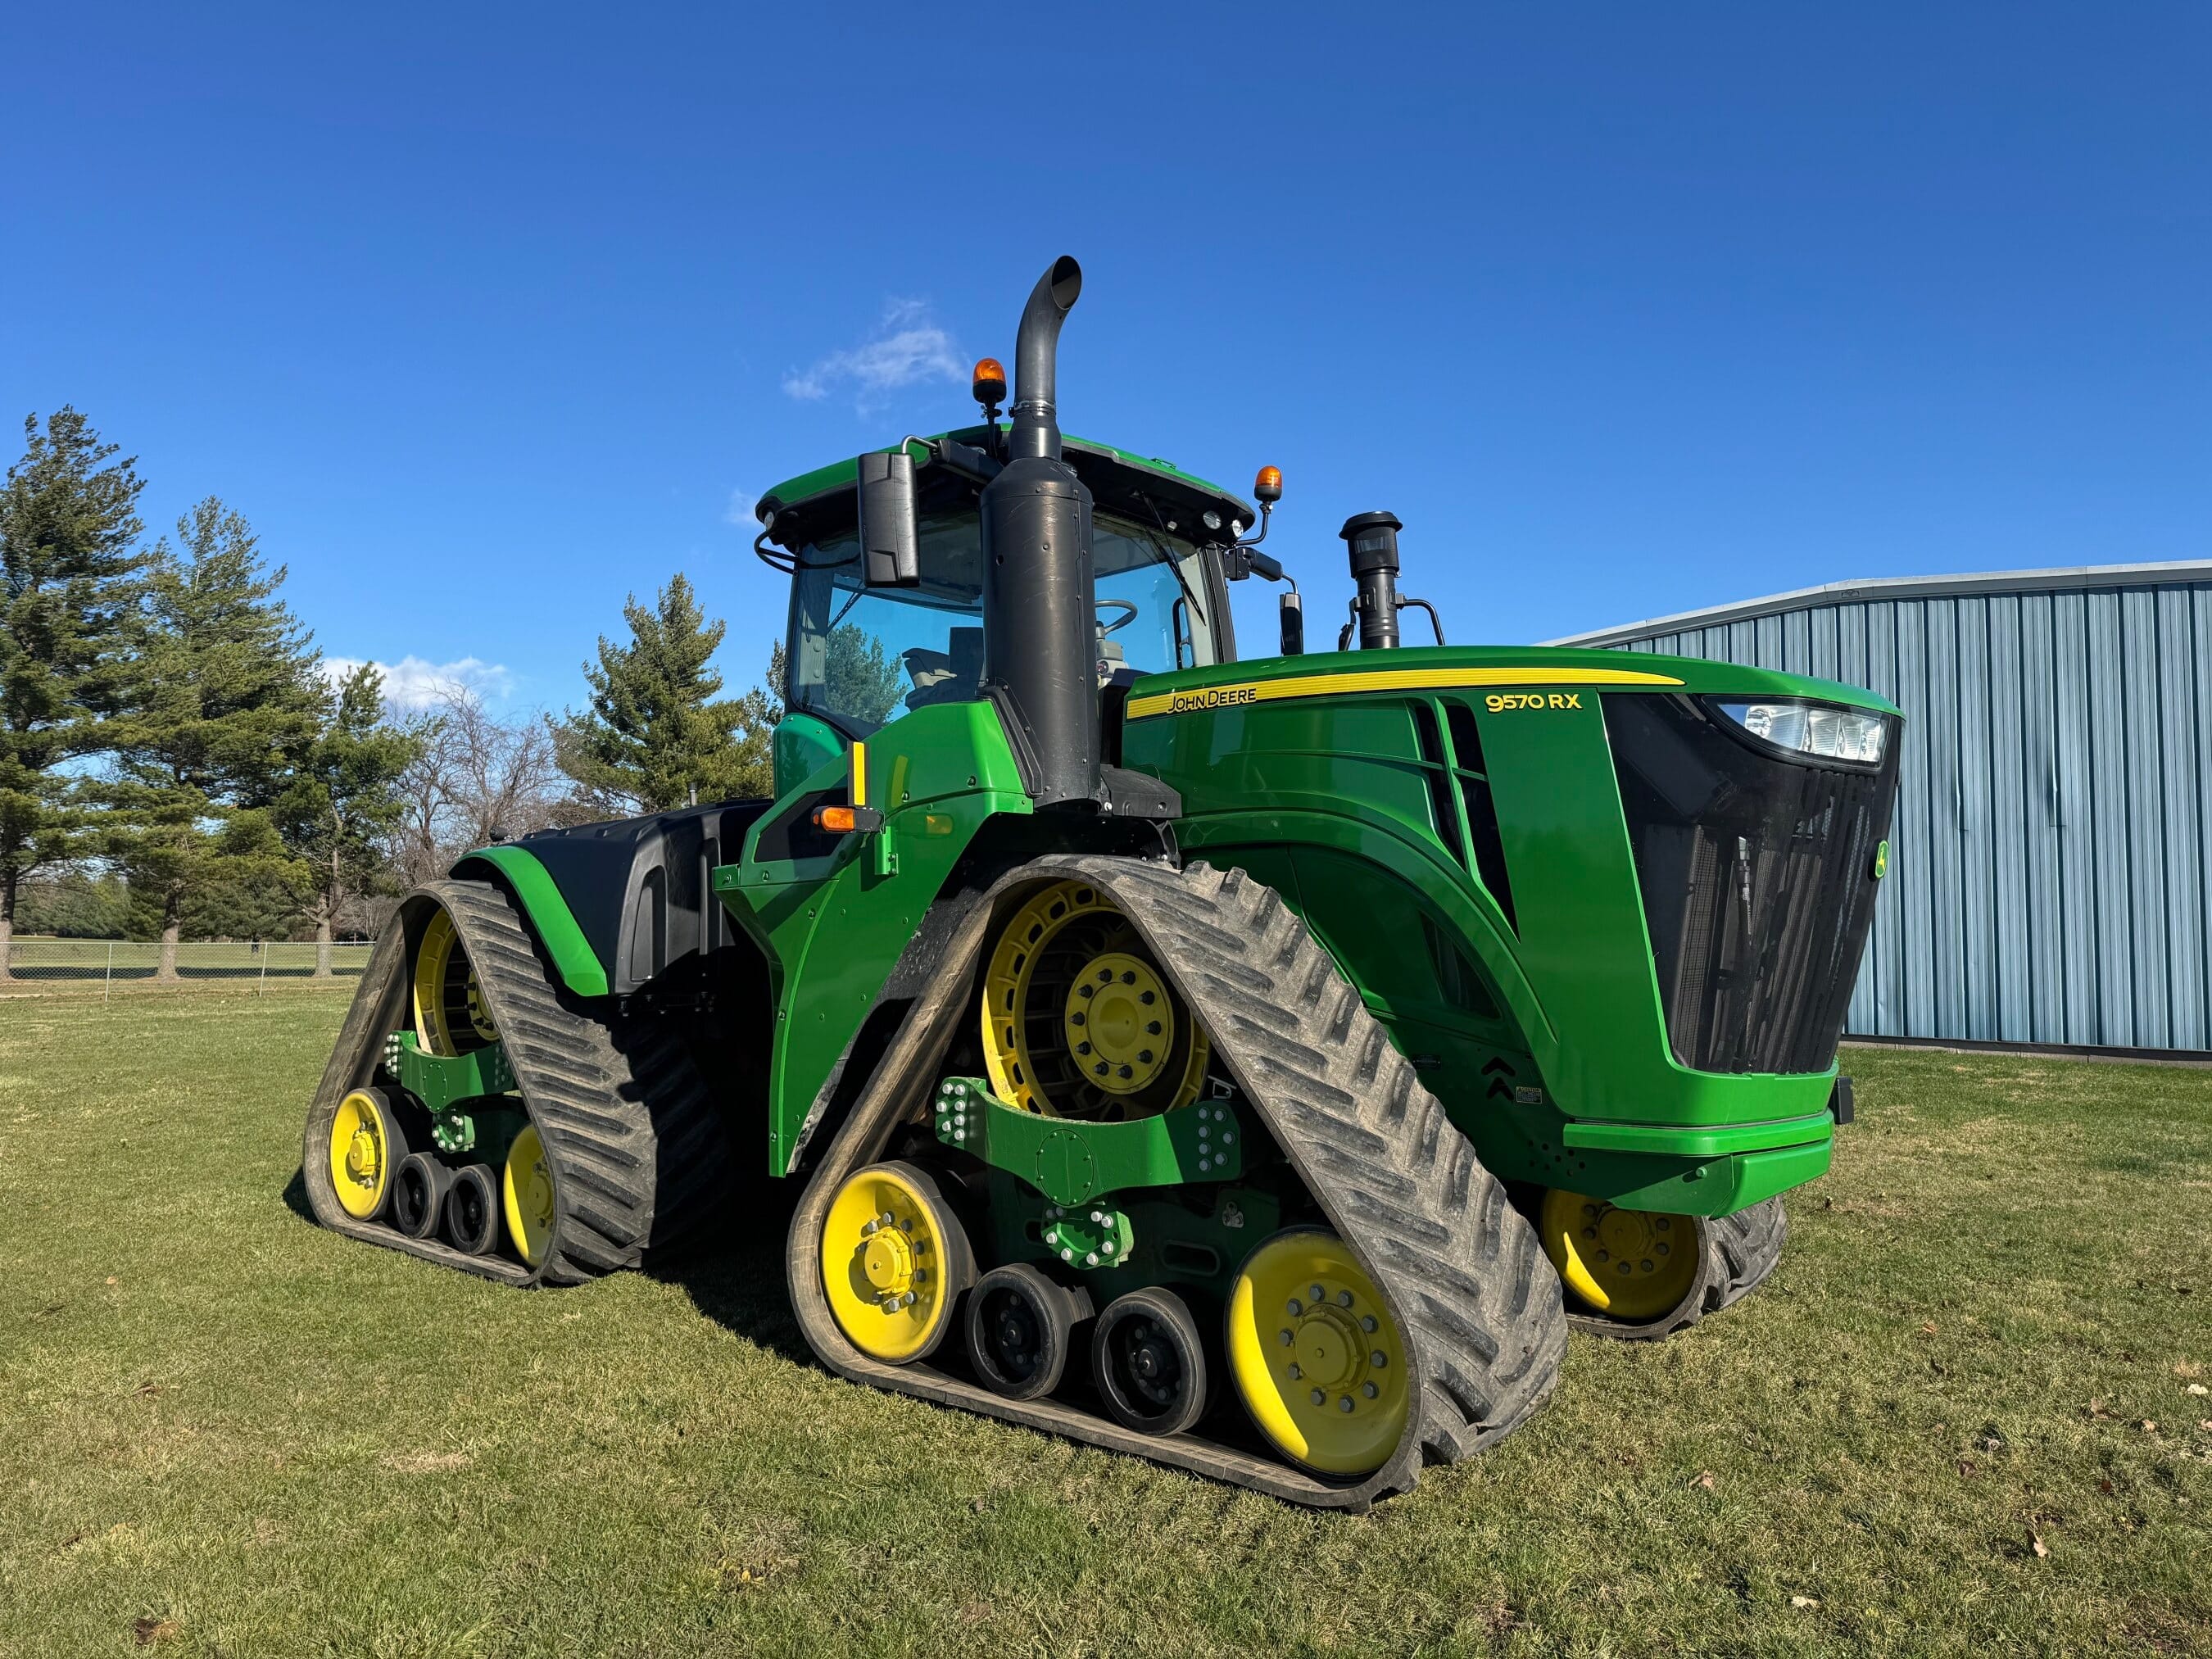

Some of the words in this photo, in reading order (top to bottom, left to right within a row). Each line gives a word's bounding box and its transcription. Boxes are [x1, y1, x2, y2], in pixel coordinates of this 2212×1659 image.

[1167, 694, 1205, 712] JOHN
[1208, 688, 1257, 706] DEERE
[1485, 694, 1545, 713] 9570
[1548, 693, 1583, 709] RX
